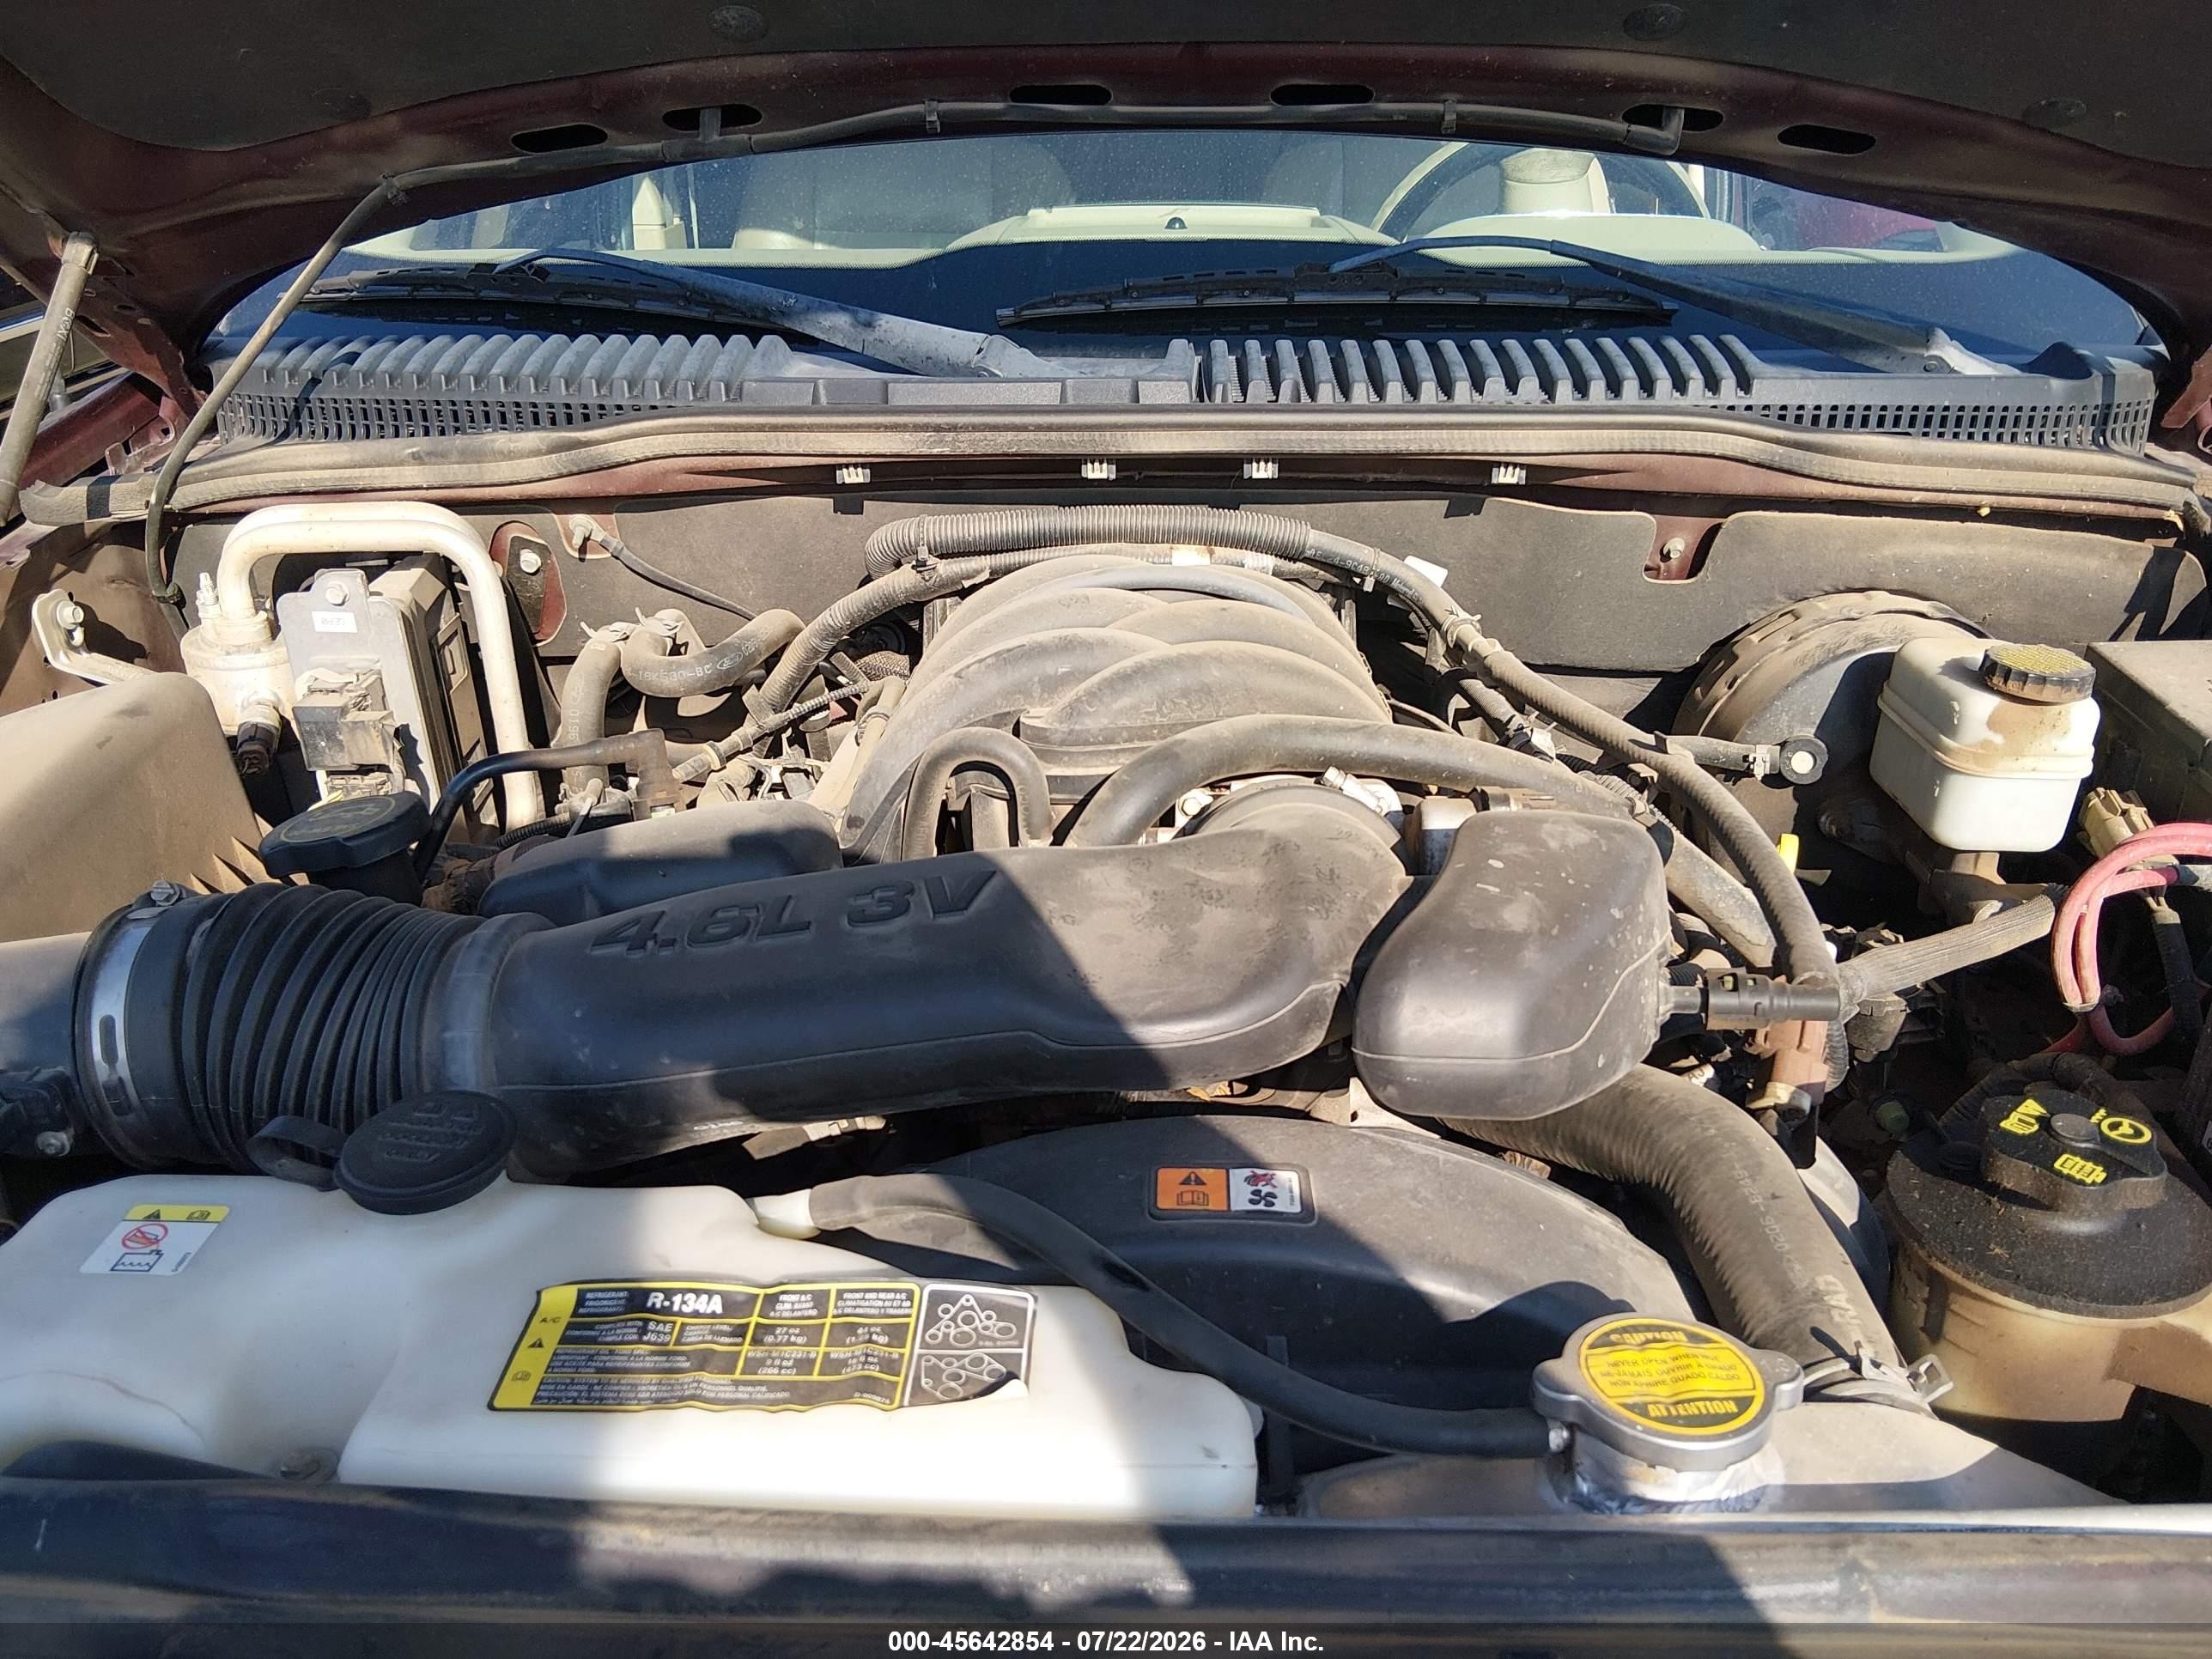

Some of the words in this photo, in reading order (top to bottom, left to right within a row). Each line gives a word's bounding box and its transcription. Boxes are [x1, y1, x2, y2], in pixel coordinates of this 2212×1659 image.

[588, 895, 815, 957] 4.6L
[844, 870, 997, 928] 3V
[779, 1293, 799, 1302] FRONT
[843, 1291, 864, 1300] FRONT
[646, 1291, 723, 1315] R-134A
[782, 1309, 818, 1317] DELANTERO
[648, 1321, 674, 1333] SAE
[642, 1331, 672, 1343] J639
[763, 1334, 790, 1346] (0.77
[790, 1334, 807, 1346] kg)
[872, 1333, 889, 1345] kg)
[1608, 1330, 1689, 1346] CAUTION
[1607, 1358, 1642, 1369] NEVER
[1643, 1358, 1668, 1366] OPEN
[1670, 1352, 1698, 1363] WHEN
[757, 1365, 780, 1375] (266
[781, 1364, 796, 1375] cc)
[864, 1363, 880, 1372] cc)
[1616, 1369, 1655, 1378] JAMAIS
[1656, 1364, 1693, 1376] OUVRIR
[1609, 1379, 1632, 1388] NON
[1707, 1373, 1741, 1382] CALDO
[1647, 1400, 1739, 1418] ATTENTION
